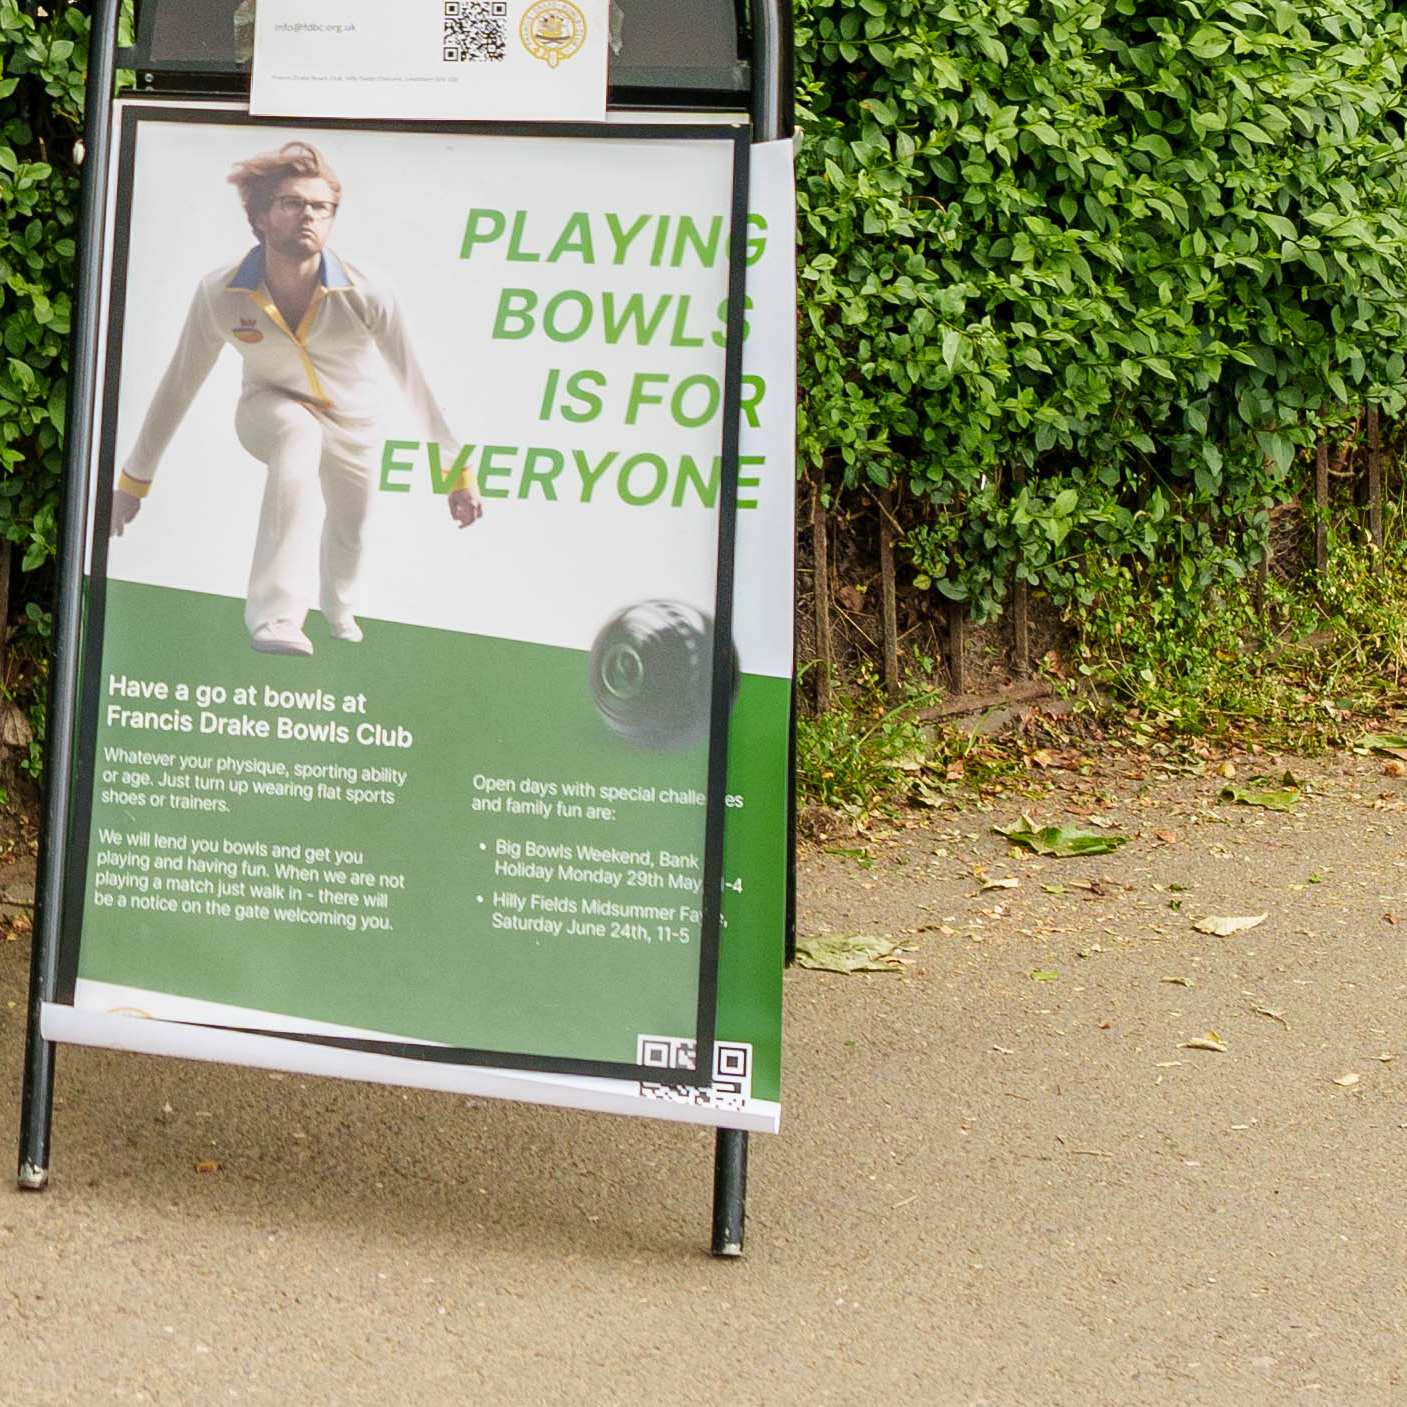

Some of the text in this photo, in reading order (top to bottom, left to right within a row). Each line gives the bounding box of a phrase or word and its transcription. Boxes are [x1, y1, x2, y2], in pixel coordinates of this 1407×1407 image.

[459, 208, 768, 269] PLAYING
[491, 288, 754, 349] BOWLS
[539, 369, 767, 428] IS FOR
[378, 440, 767, 510] EVERYONE
[109, 674, 366, 713] Have a go at bowls at
[107, 704, 413, 748] Francis Drake Bowls Club
[103, 746, 407, 787] Whatever your physique, sporting ability
[101, 788, 230, 812] shoes or trainers.
[102, 769, 395, 804] or age. Just turn up wearing flat sports
[472, 774, 744, 808] Open days with special challees
[471, 797, 615, 820] and family fun are:
[98, 828, 363, 866] We will lend you bowls and get you
[496, 838, 698, 869] Big Bowls Weekend, Bank
[96, 849, 404, 888] playing and having fun. When we are not
[494, 859, 554, 882] Holiday
[558, 864, 622, 888] Monday
[626, 869, 663, 887] 29th
[95, 870, 148, 892] playing
[152, 876, 162, 889] a
[166, 877, 213, 893] match
[216, 879, 245, 898] just
[249, 883, 284, 900] walk
[288, 885, 302, 901] in
[318, 887, 359, 906] there
[362, 893, 387, 907] will
[493, 891, 526, 912] Hilly
[530, 893, 577, 913] Fields
[581, 898, 676, 920] Midsummer
[94, 889, 393, 931] be a notice on the gate welcoming you.
[492, 911, 689, 943] Saturday June 24th, 11-5
